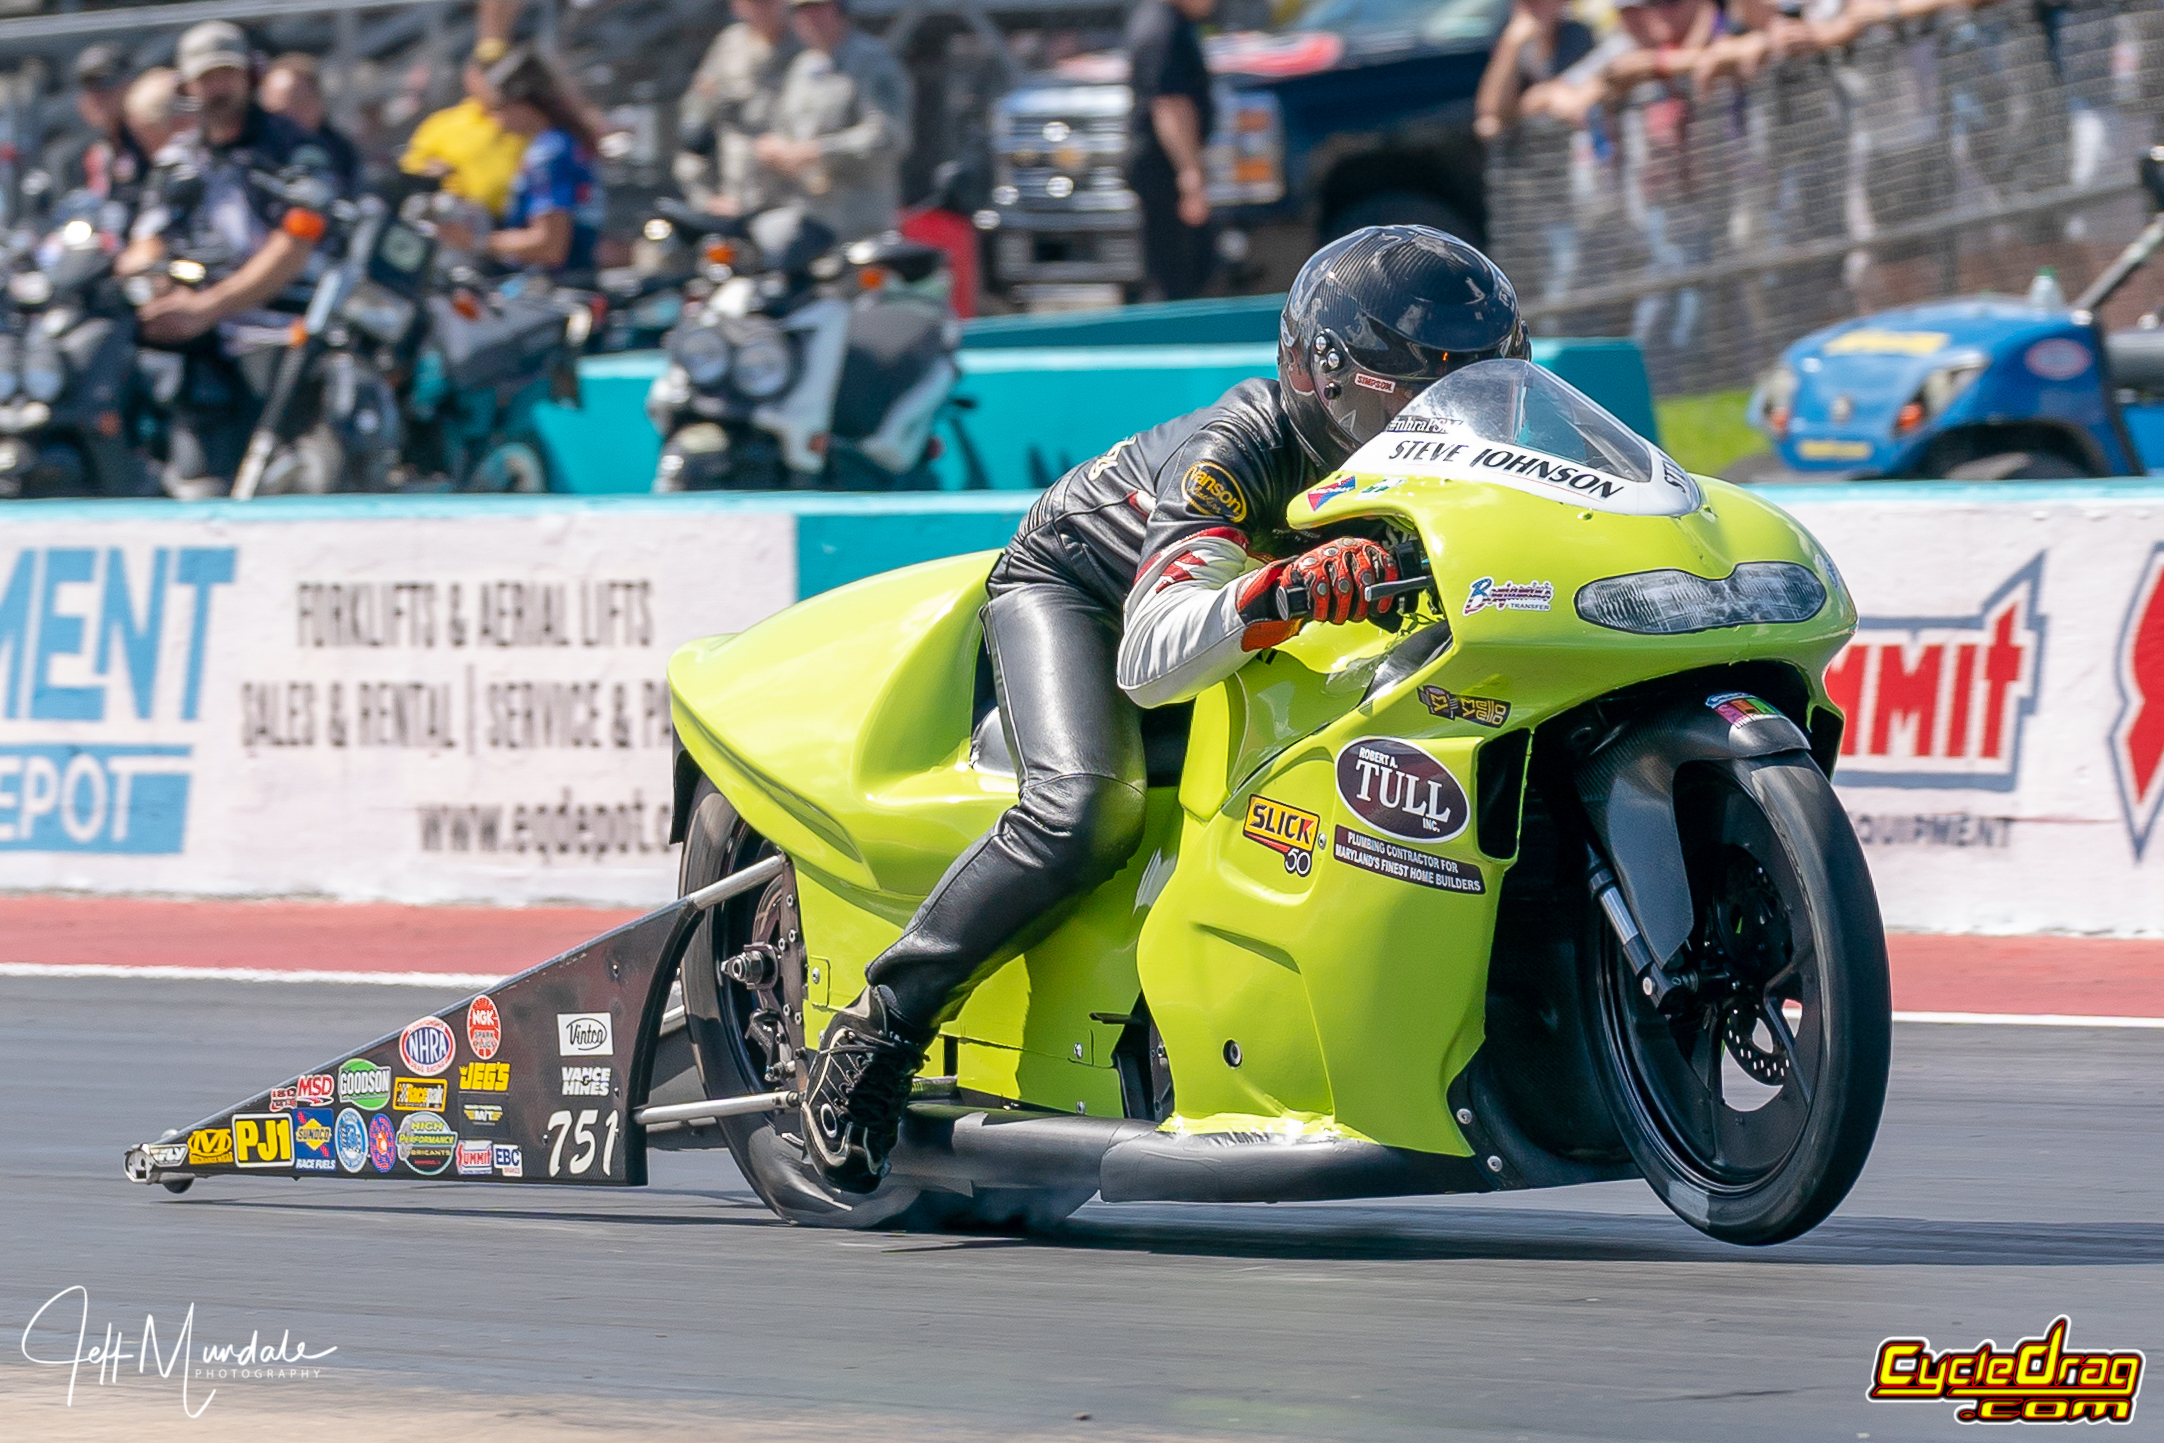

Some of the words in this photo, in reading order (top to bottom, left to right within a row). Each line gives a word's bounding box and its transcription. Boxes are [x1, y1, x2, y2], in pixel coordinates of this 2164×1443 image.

[1388, 440, 1470, 462] STEVE
[1468, 447, 1625, 500] JOHNSON
[297, 582, 435, 648] FORKLIFTS
[449, 582, 468, 648] &
[479, 582, 569, 648] AERIAL
[579, 580, 654, 648] LIFTS
[1510, 602, 1550, 611] TRANSFER
[241, 681, 315, 748] SALES
[328, 681, 347, 748] &
[358, 681, 457, 748] RENTAL
[487, 681, 602, 748] SERVICE
[611, 681, 632, 748] &
[1359, 746, 1390, 766] ROBERT
[1389, 756, 1399, 769] A.
[1355, 758, 1452, 823] TULL
[1249, 803, 1315, 845] SLICK
[1422, 817, 1441, 833] INC.
[1850, 812, 2014, 848] QUIPMENT
[1284, 847, 1311, 875] 50
[1347, 831, 1386, 854] PLUMBING
[1386, 844, 1441, 869] CONTRACTOR
[1441, 859, 1459, 874] FOR
[1335, 843, 1381, 870] MARYLAND'S
[1381, 859, 1409, 878] FINEST
[1409, 867, 1435, 884] HOME
[1435, 873, 1481, 892] BUILDERS
[472, 1009, 495, 1026] NGK
[408, 1027, 448, 1064] NHRA
[474, 1031, 494, 1039] SPARK
[474, 1039, 495, 1049] PLUGS
[340, 1069, 390, 1095] GOODSON
[561, 1066, 612, 1082] VANCE
[297, 1075, 334, 1098] MSD
[562, 1081, 610, 1097] HINES
[297, 1127, 331, 1141] SUNOCO
[411, 1121, 444, 1131] HIGH
[235, 1119, 291, 1161] PJ1
[398, 1133, 455, 1144] PERFORMANCE
[547, 1109, 620, 1178] 751
[296, 1158, 316, 1169] RACE
[316, 1158, 336, 1170] FUELS
[495, 1147, 520, 1166] EBC
